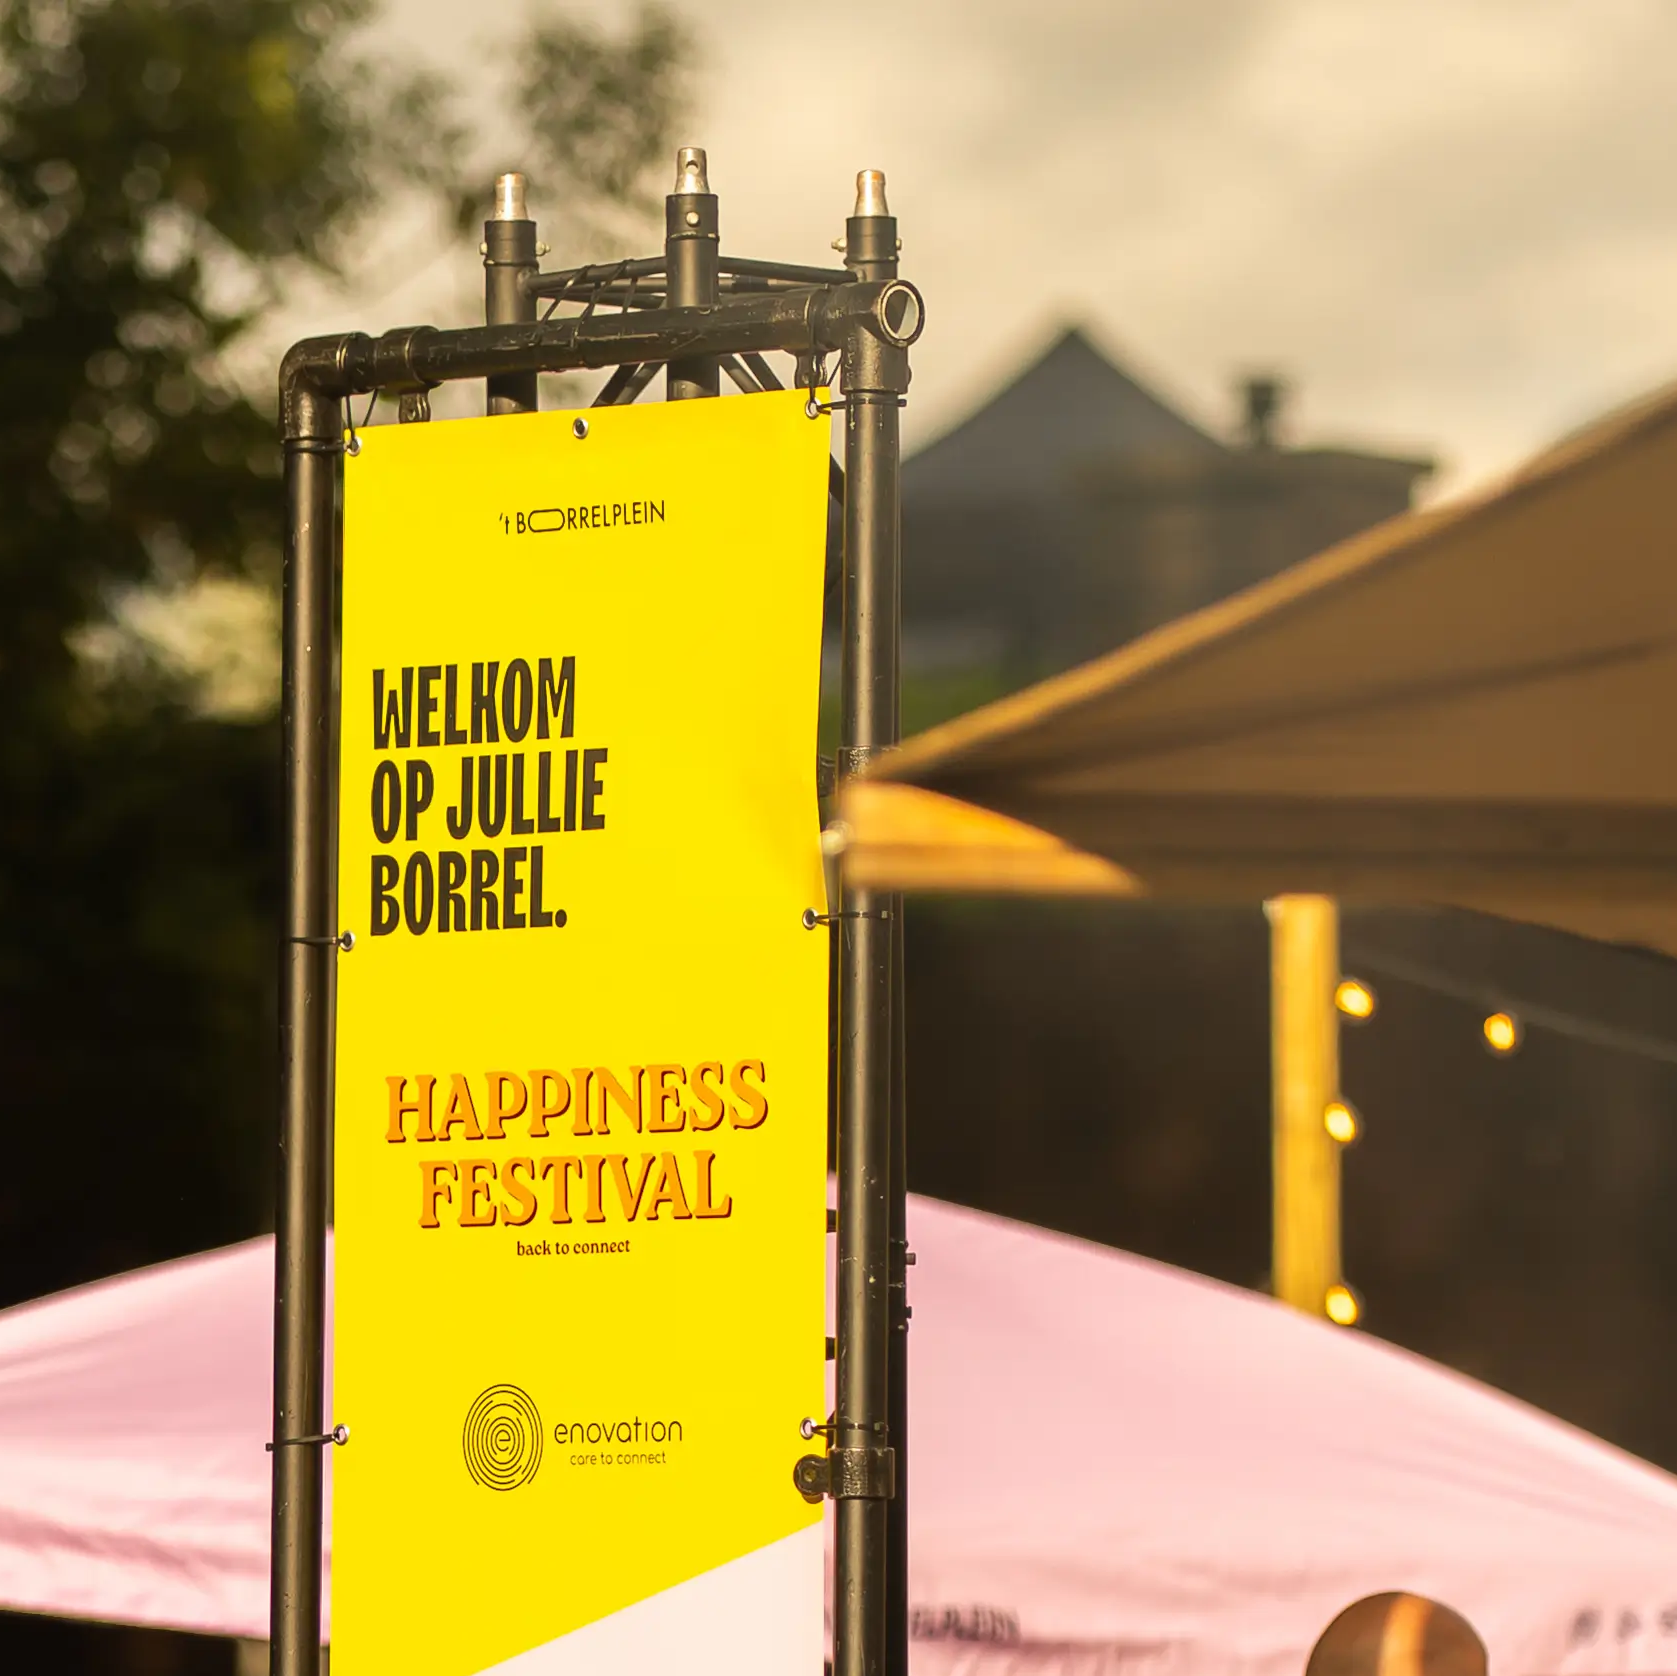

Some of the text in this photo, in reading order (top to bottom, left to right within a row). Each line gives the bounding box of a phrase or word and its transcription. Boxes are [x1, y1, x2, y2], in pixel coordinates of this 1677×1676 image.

[372, 656, 576, 750] WELKOM
[370, 748, 609, 844] OP JULLIE
[370, 845, 568, 937] BORREL.
[385, 1058, 769, 1143] HAPPINESS
[418, 1150, 733, 1229] FESTIVAL
[516, 1240, 631, 1256] back to connect
[553, 1416, 683, 1444] enovation
[570, 1451, 666, 1466] care to connect
